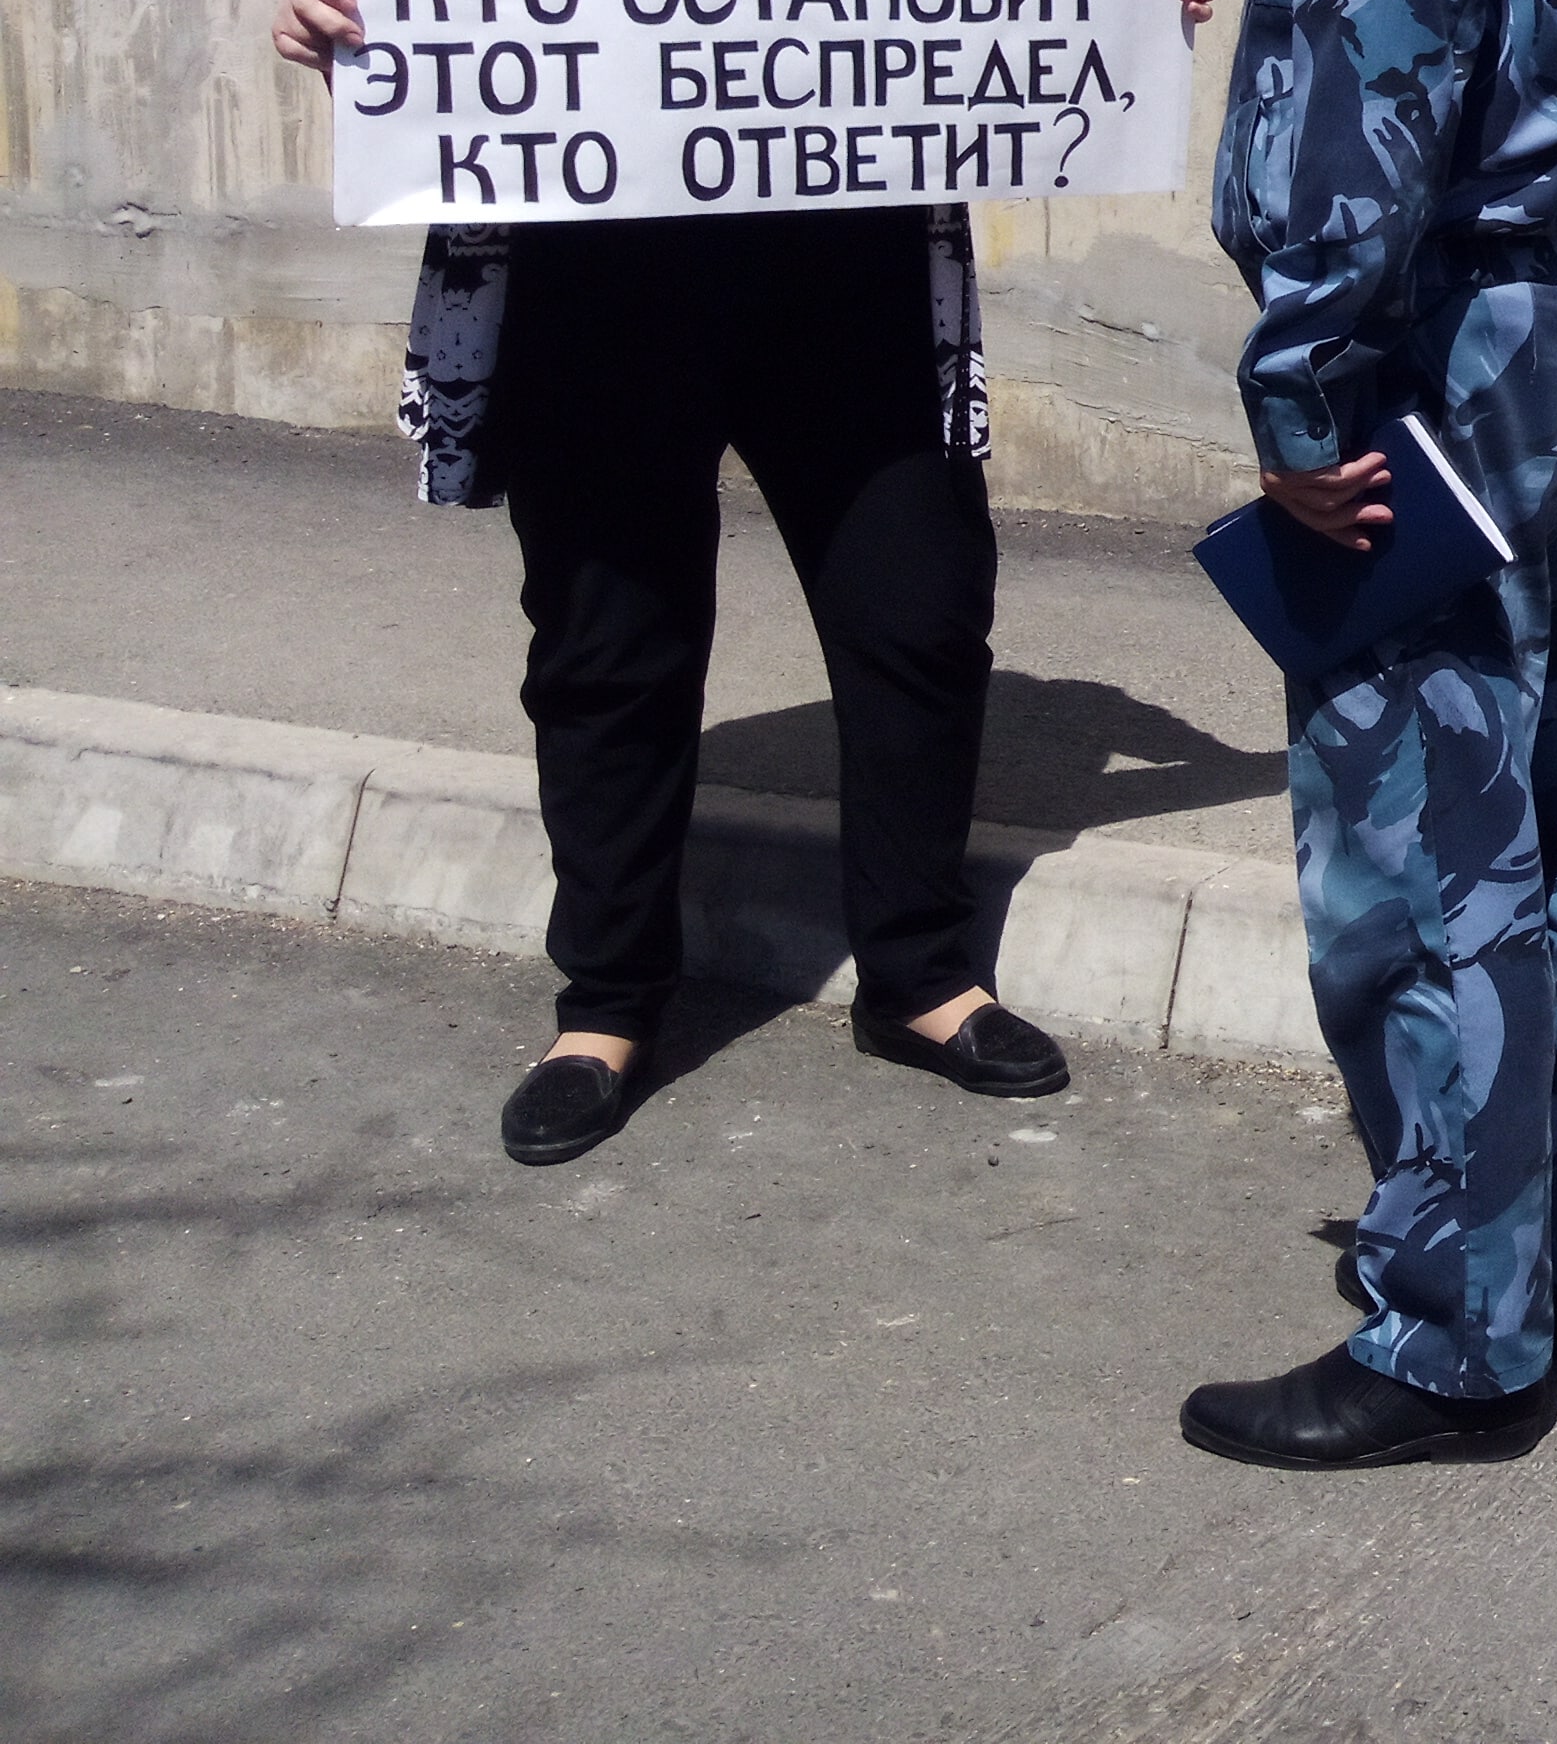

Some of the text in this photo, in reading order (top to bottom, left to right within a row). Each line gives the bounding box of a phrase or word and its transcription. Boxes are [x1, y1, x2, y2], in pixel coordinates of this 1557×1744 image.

[355, 38, 1136, 117] ЭТОТ БЕСПРЕДЕЛ,
[439, 107, 1092, 207] КТО ОТВЕТИТ?
